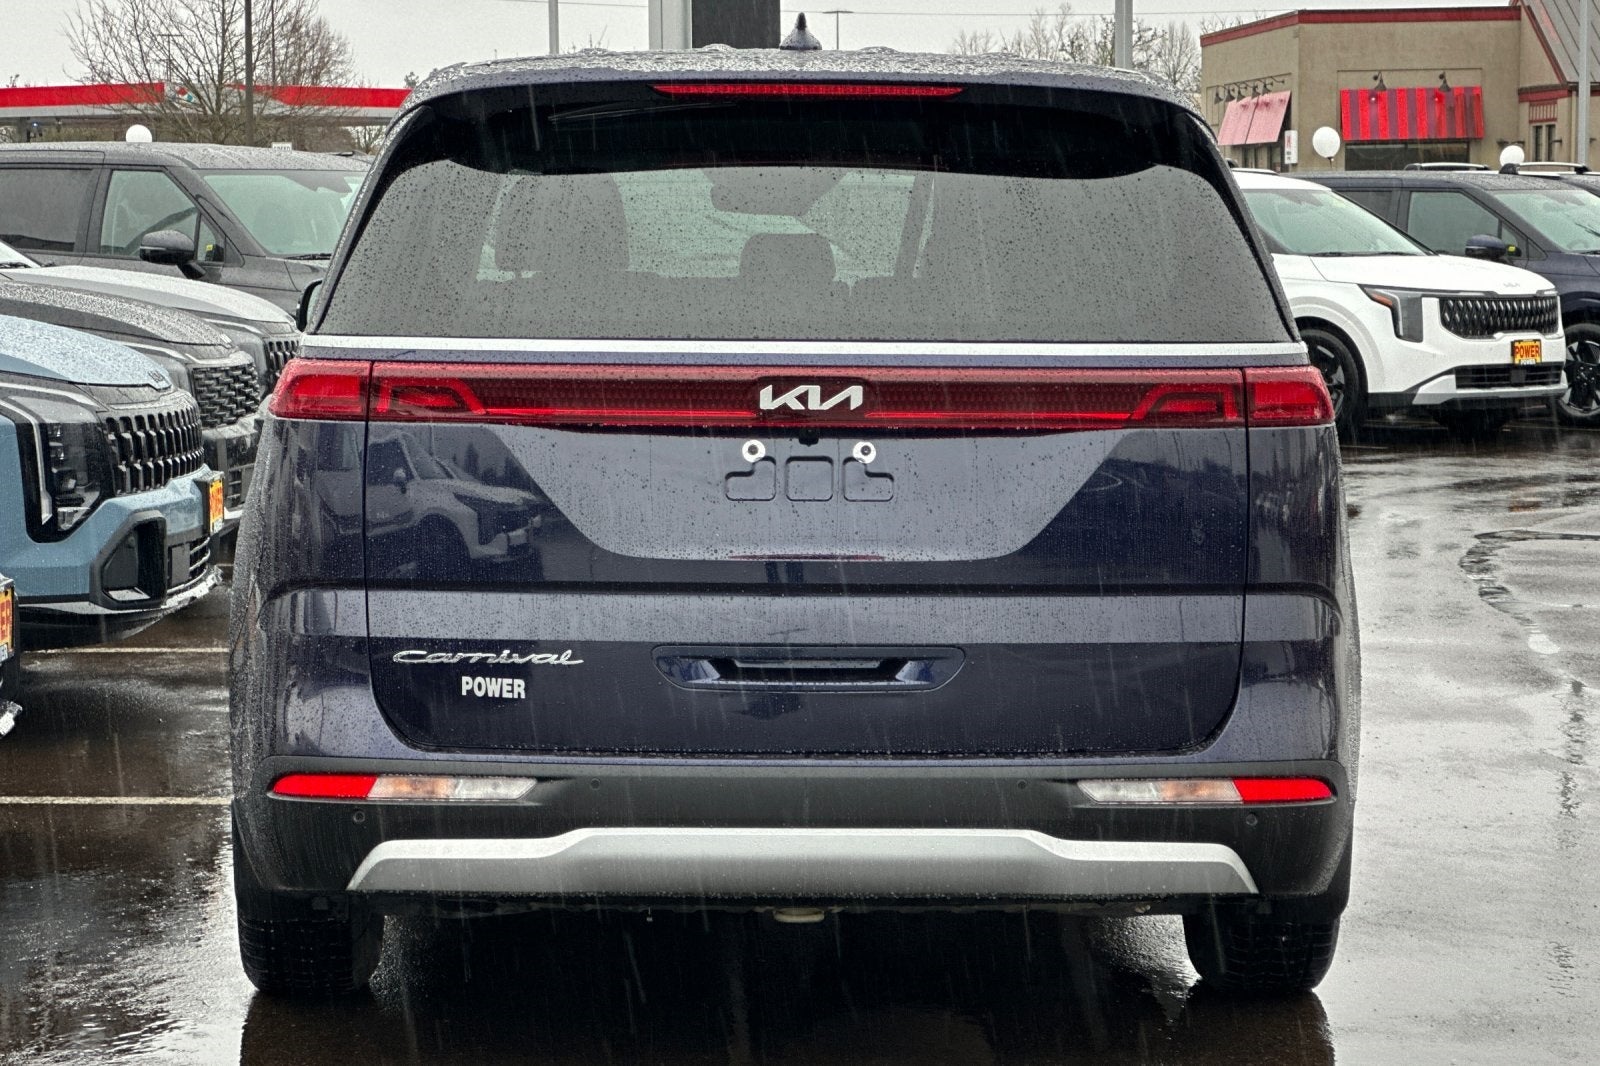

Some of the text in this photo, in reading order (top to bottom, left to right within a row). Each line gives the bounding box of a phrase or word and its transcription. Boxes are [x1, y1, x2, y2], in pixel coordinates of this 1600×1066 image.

[1514, 344, 1540, 358] POWER
[760, 384, 863, 410] KIA
[393, 649, 584, 665] Carnival
[461, 676, 526, 699] POWER
